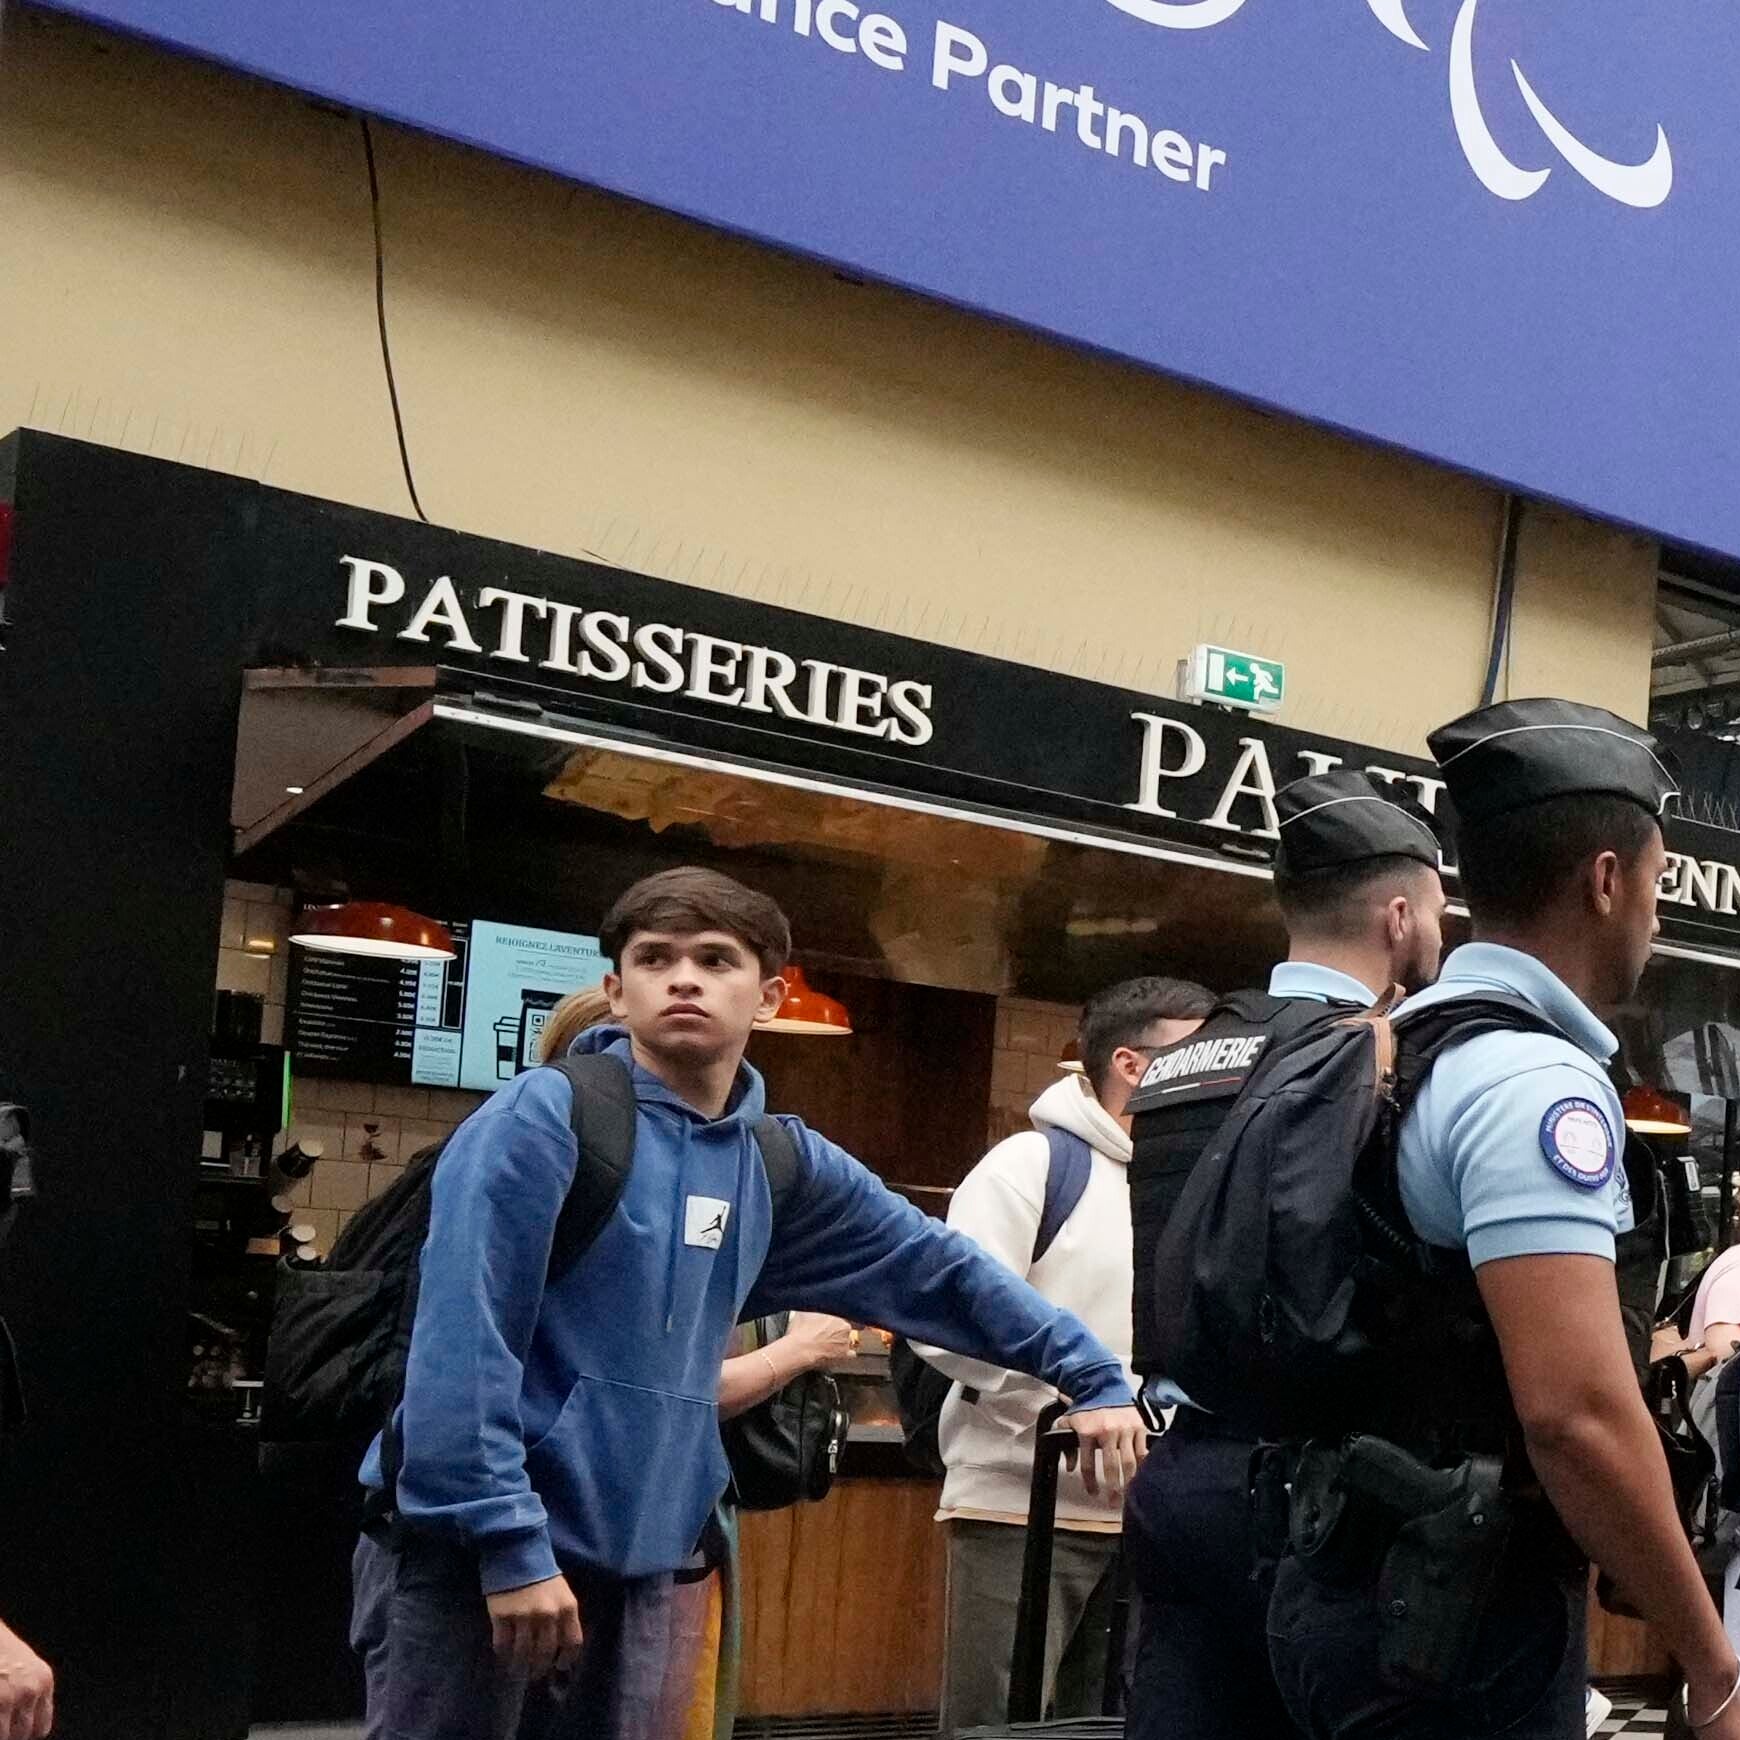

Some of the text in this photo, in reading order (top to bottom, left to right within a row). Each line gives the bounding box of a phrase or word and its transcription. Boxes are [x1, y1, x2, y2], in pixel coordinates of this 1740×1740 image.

[932, 20, 1226, 191] Partner
[335, 553, 933, 747] PATISSERIES
[1140, 1035, 1266, 1088] GENDARMERIE
